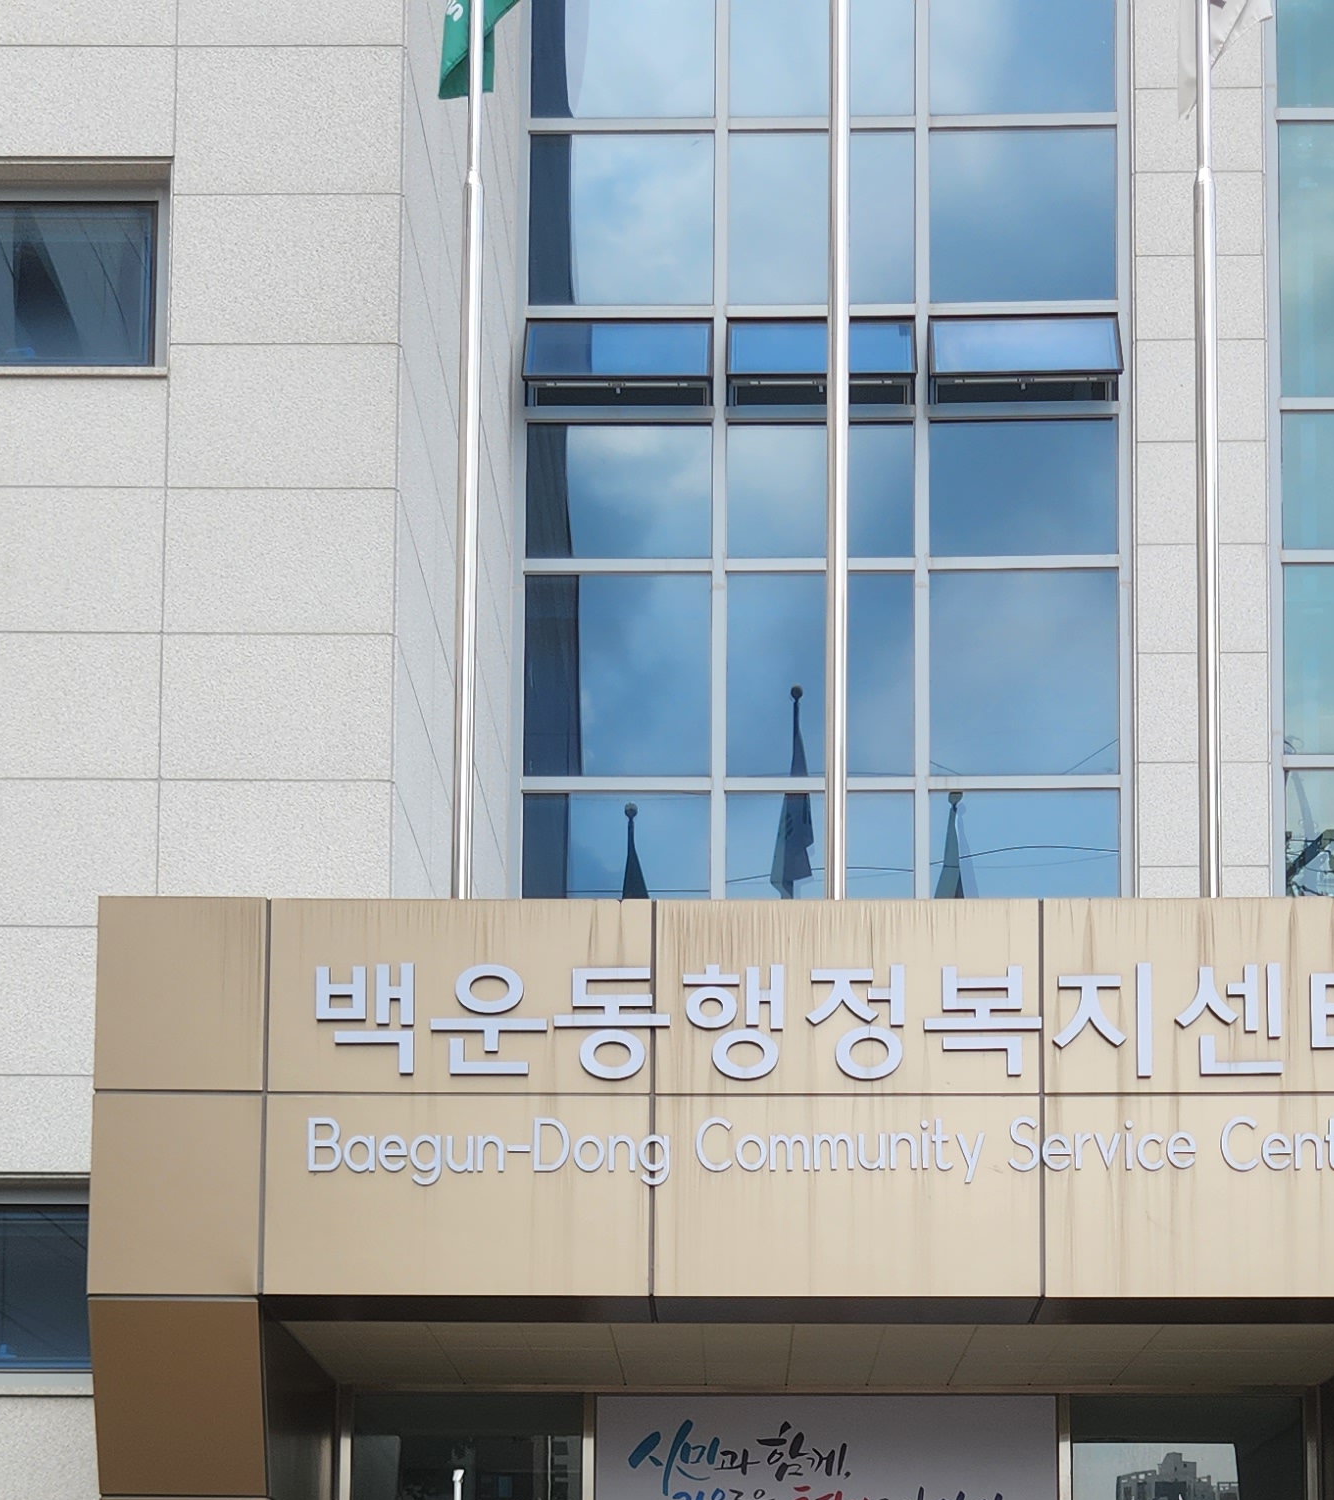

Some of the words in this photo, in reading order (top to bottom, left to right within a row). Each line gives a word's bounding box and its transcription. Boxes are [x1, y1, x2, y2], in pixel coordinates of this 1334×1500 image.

[307, 1116, 672, 1186] Baegun-Dong
[694, 1116, 986, 1184] Community
[1007, 1115, 1198, 1172] Service
[628, 1419, 760, 1497] 시민과
